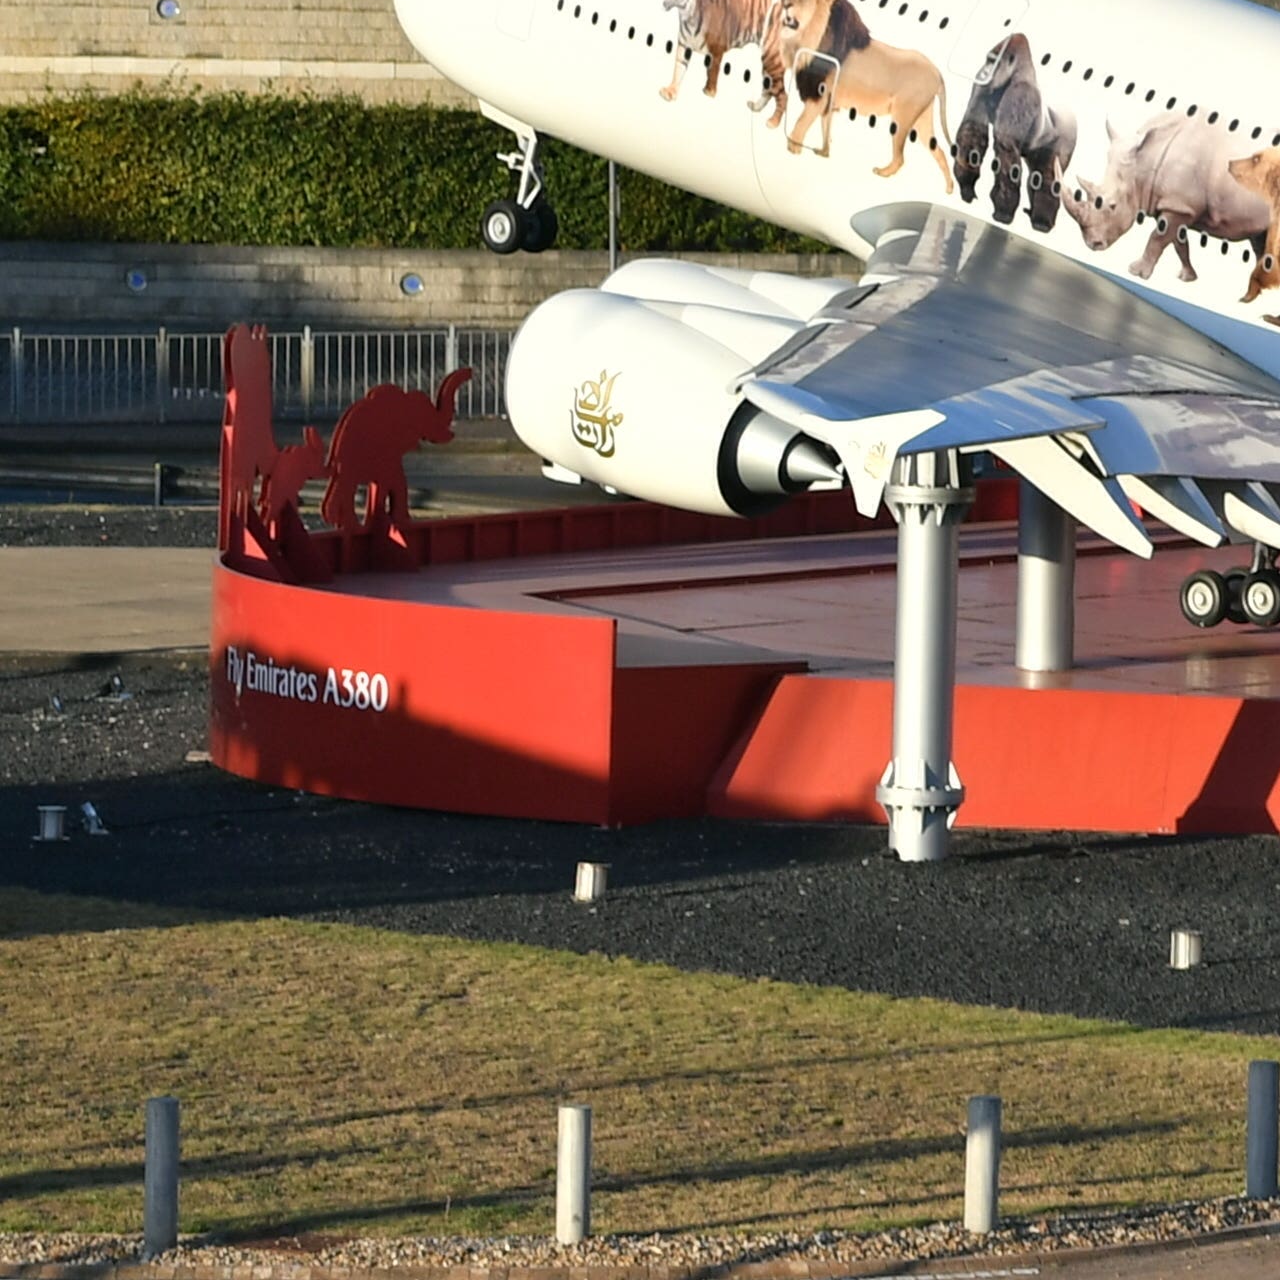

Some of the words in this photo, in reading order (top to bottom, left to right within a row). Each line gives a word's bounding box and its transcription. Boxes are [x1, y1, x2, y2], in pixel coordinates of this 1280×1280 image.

[227, 645, 244, 694] Fly
[246, 651, 318, 703] Emirates
[322, 666, 389, 713] A380
